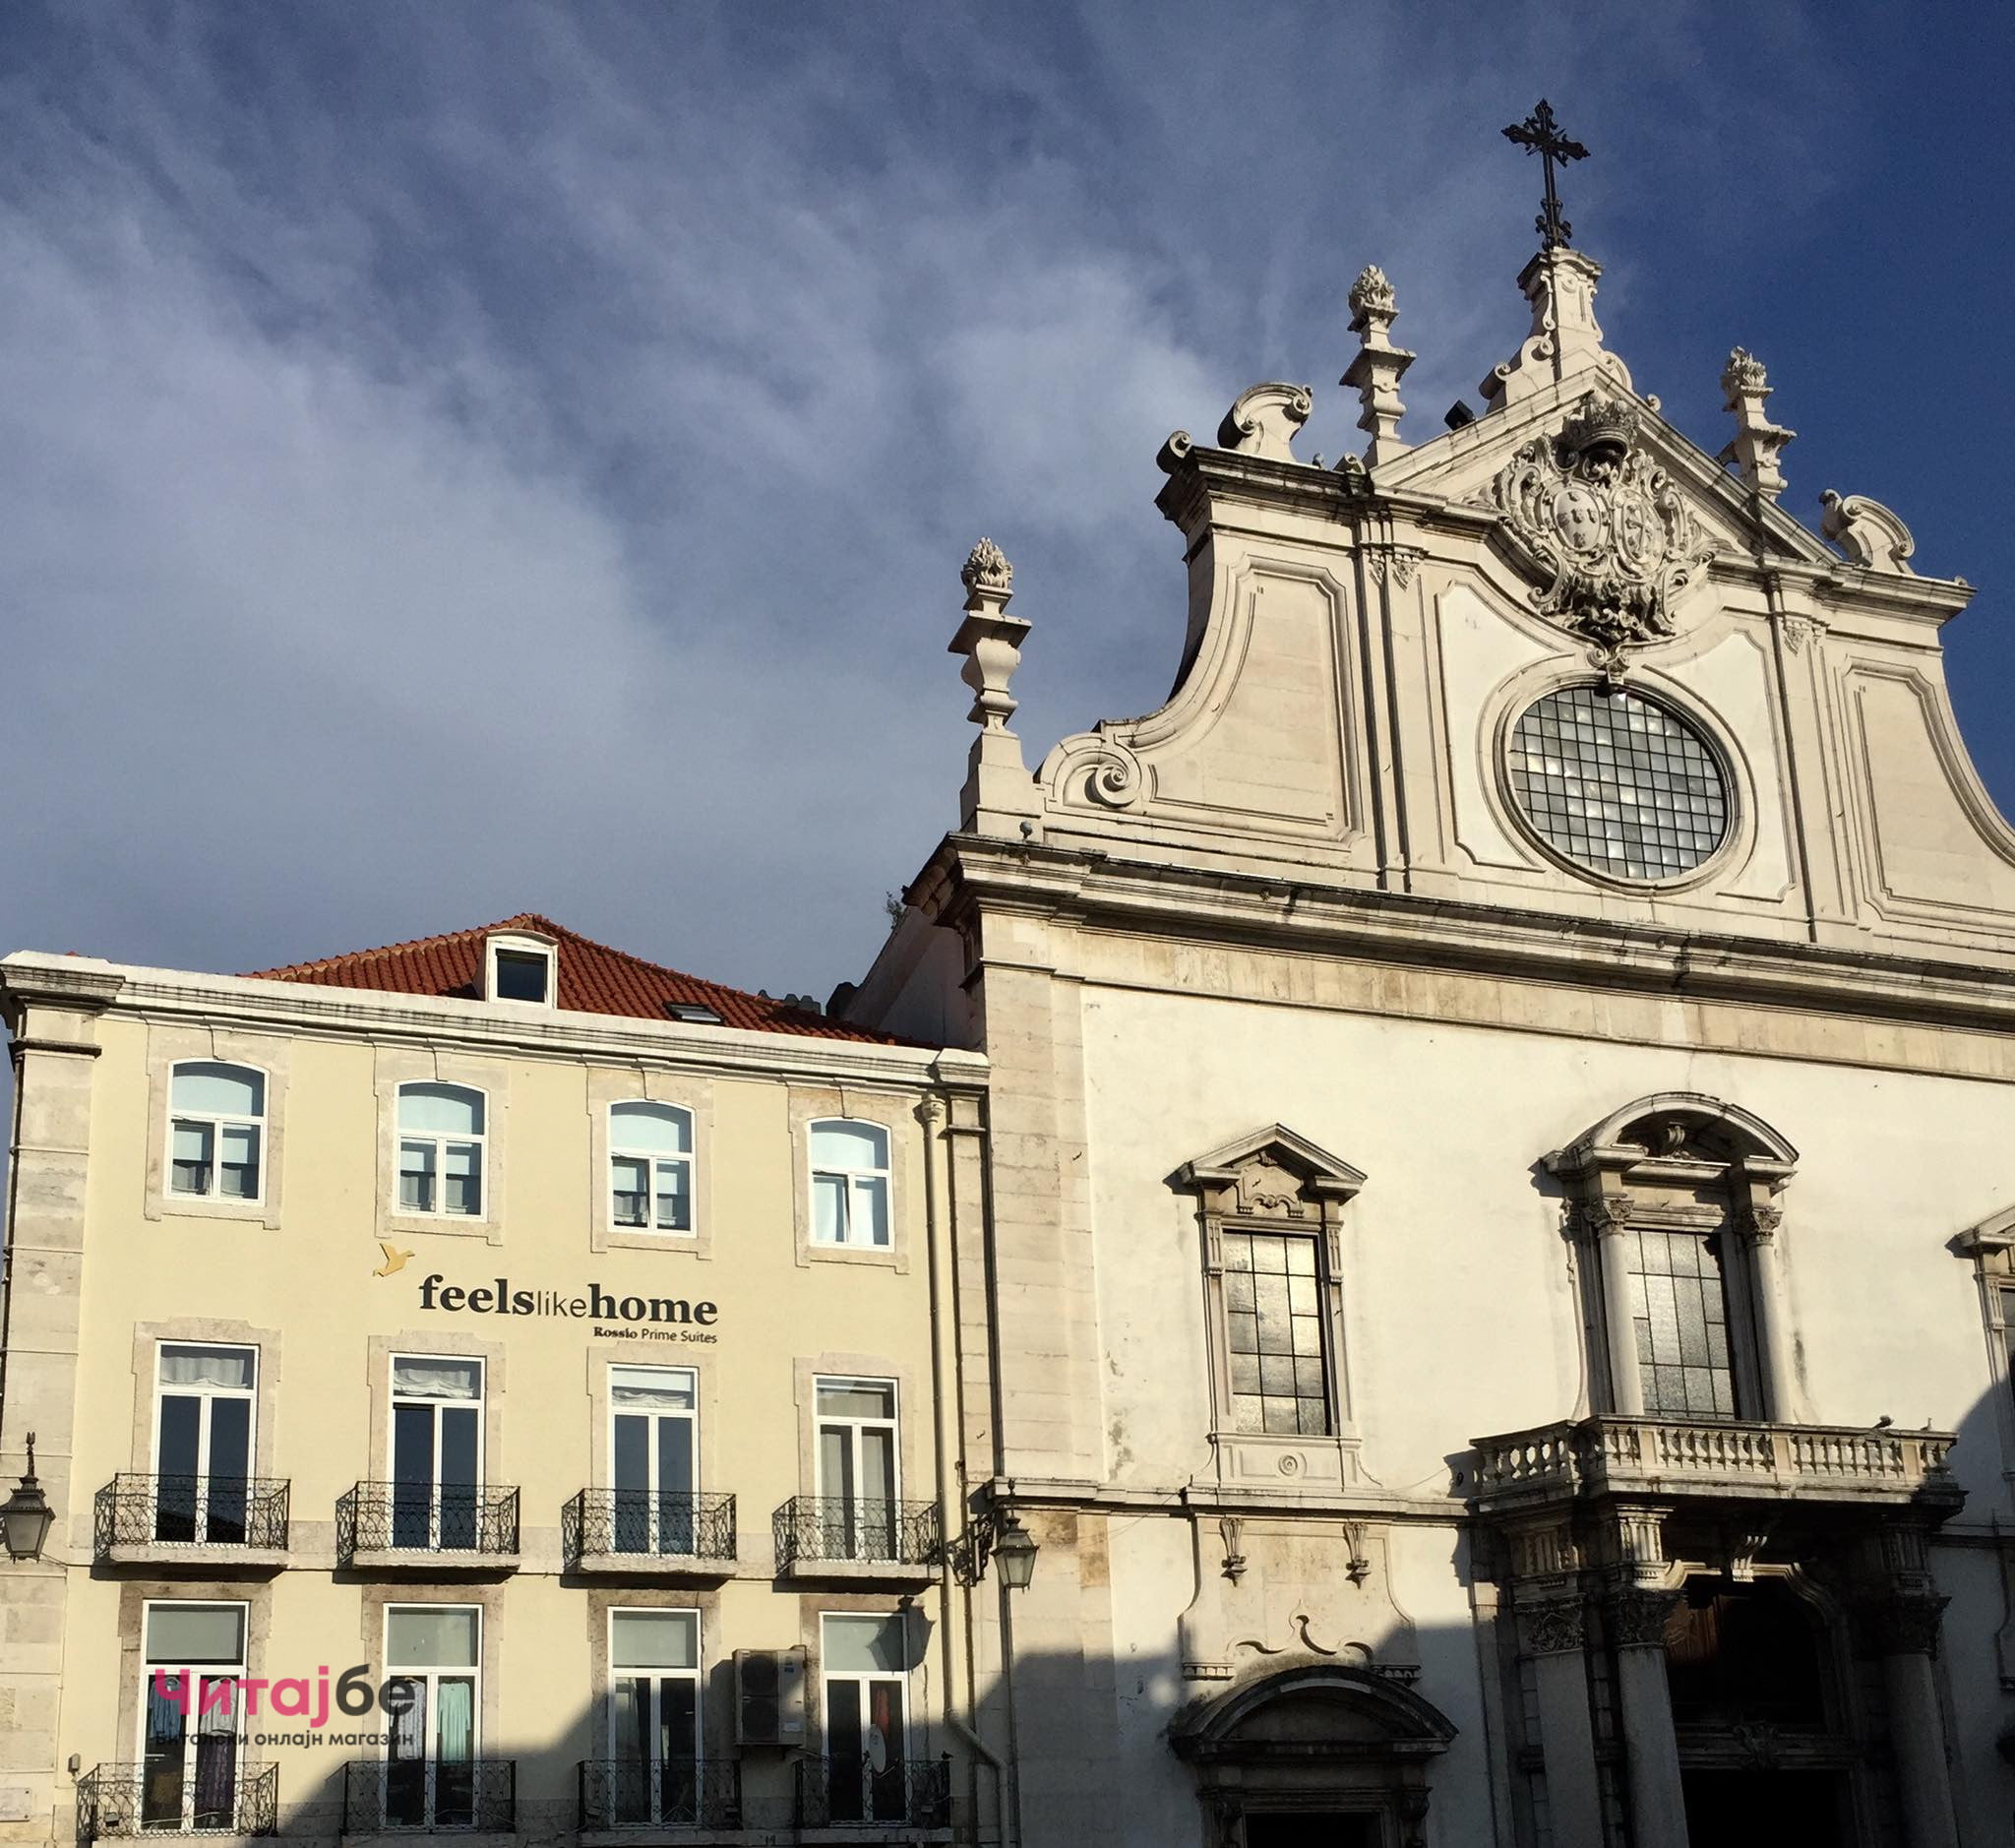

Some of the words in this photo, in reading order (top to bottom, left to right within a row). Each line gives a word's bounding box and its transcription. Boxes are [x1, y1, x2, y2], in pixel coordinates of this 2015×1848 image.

[593, 1326, 638, 1339] Rossio
[641, 1328, 677, 1341] Prime
[681, 1330, 717, 1344] Suites
